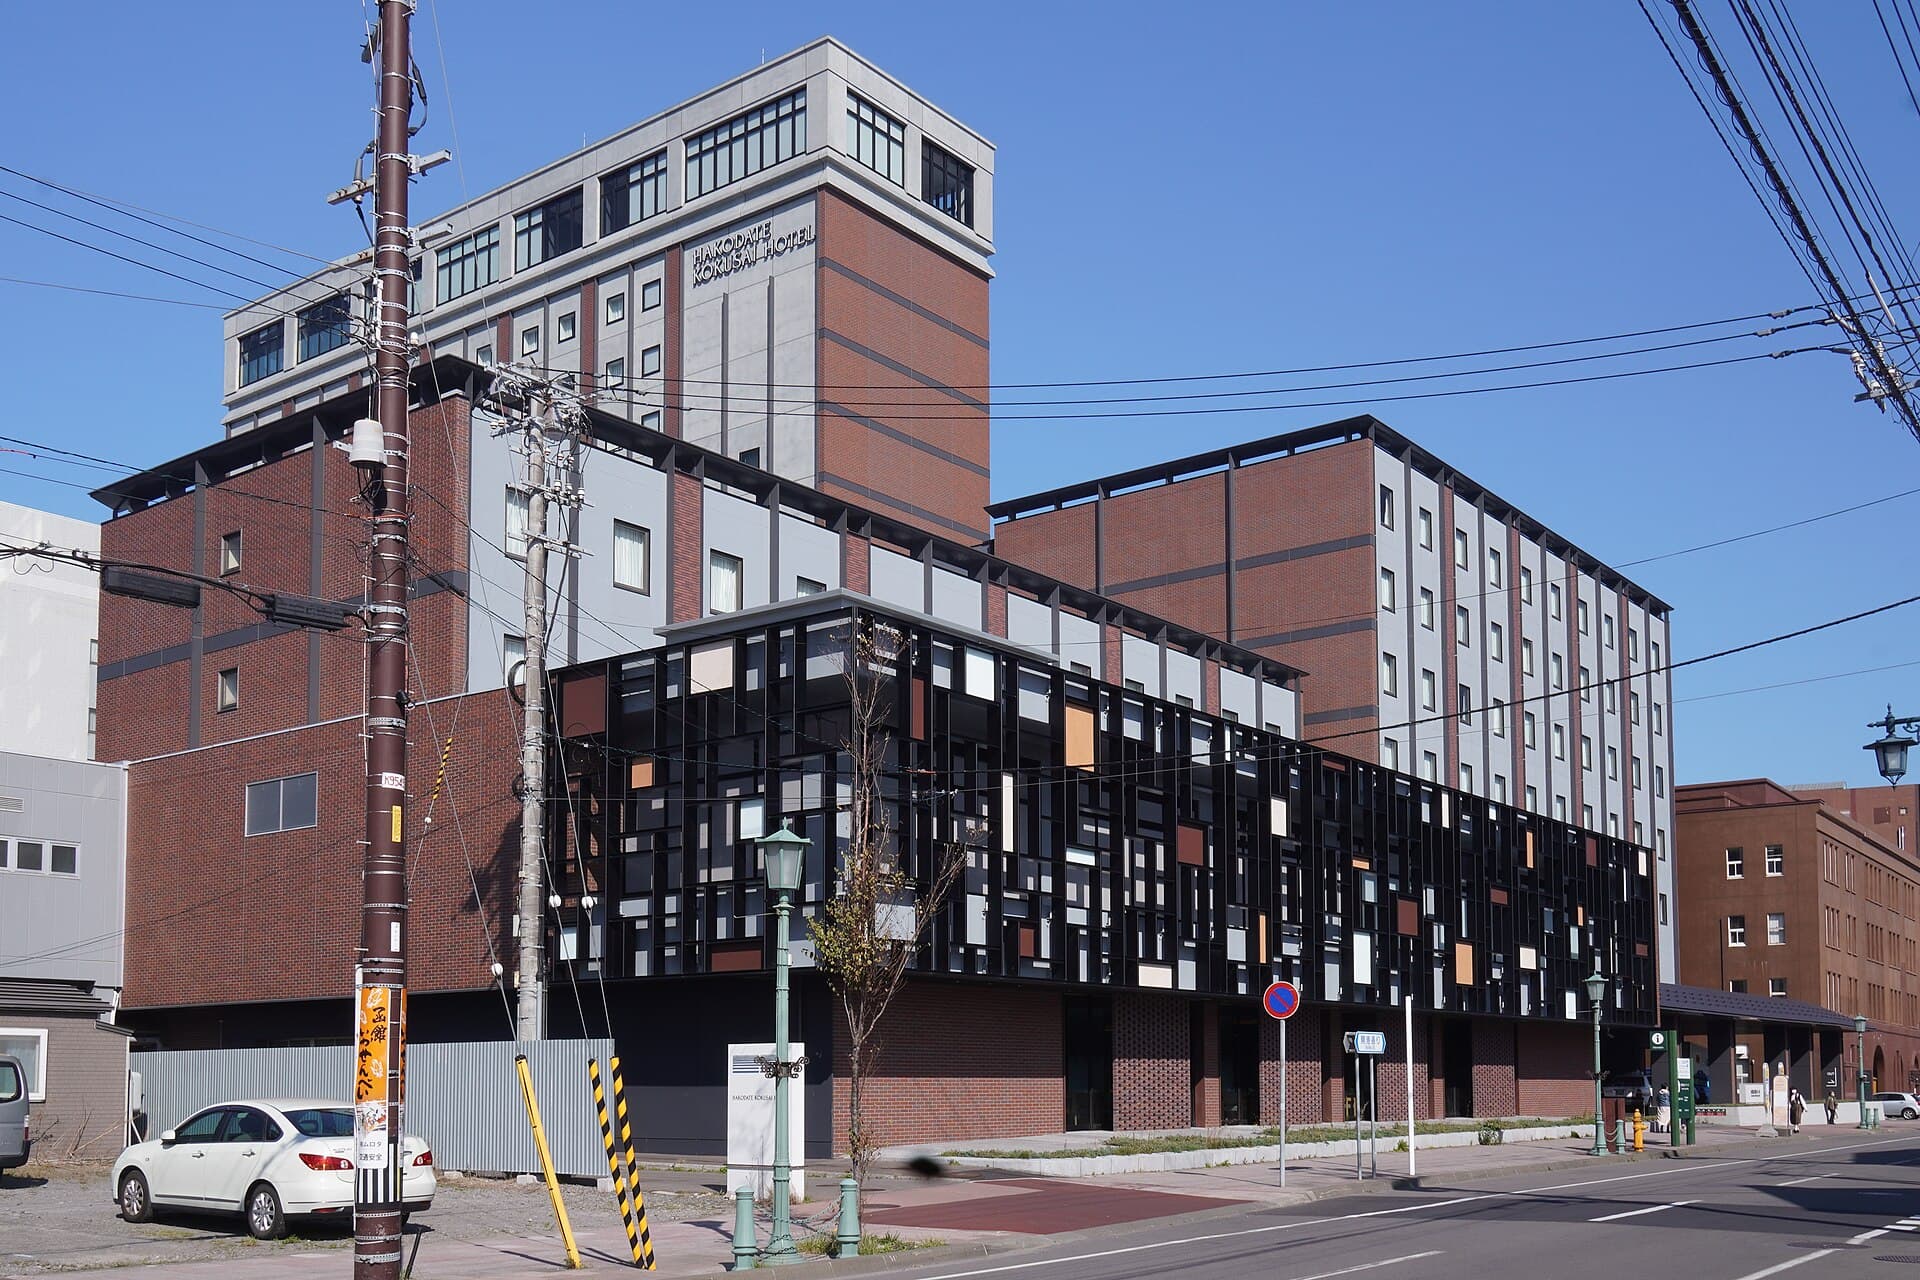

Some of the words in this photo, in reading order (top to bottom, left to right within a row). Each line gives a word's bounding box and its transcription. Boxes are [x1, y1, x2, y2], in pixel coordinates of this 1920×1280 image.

[692, 241, 759, 286] KOKUSAI
[763, 225, 816, 258] HOTEL
[693, 221, 772, 264] HAKODATE
[371, 1006, 388, 1043] 函館
